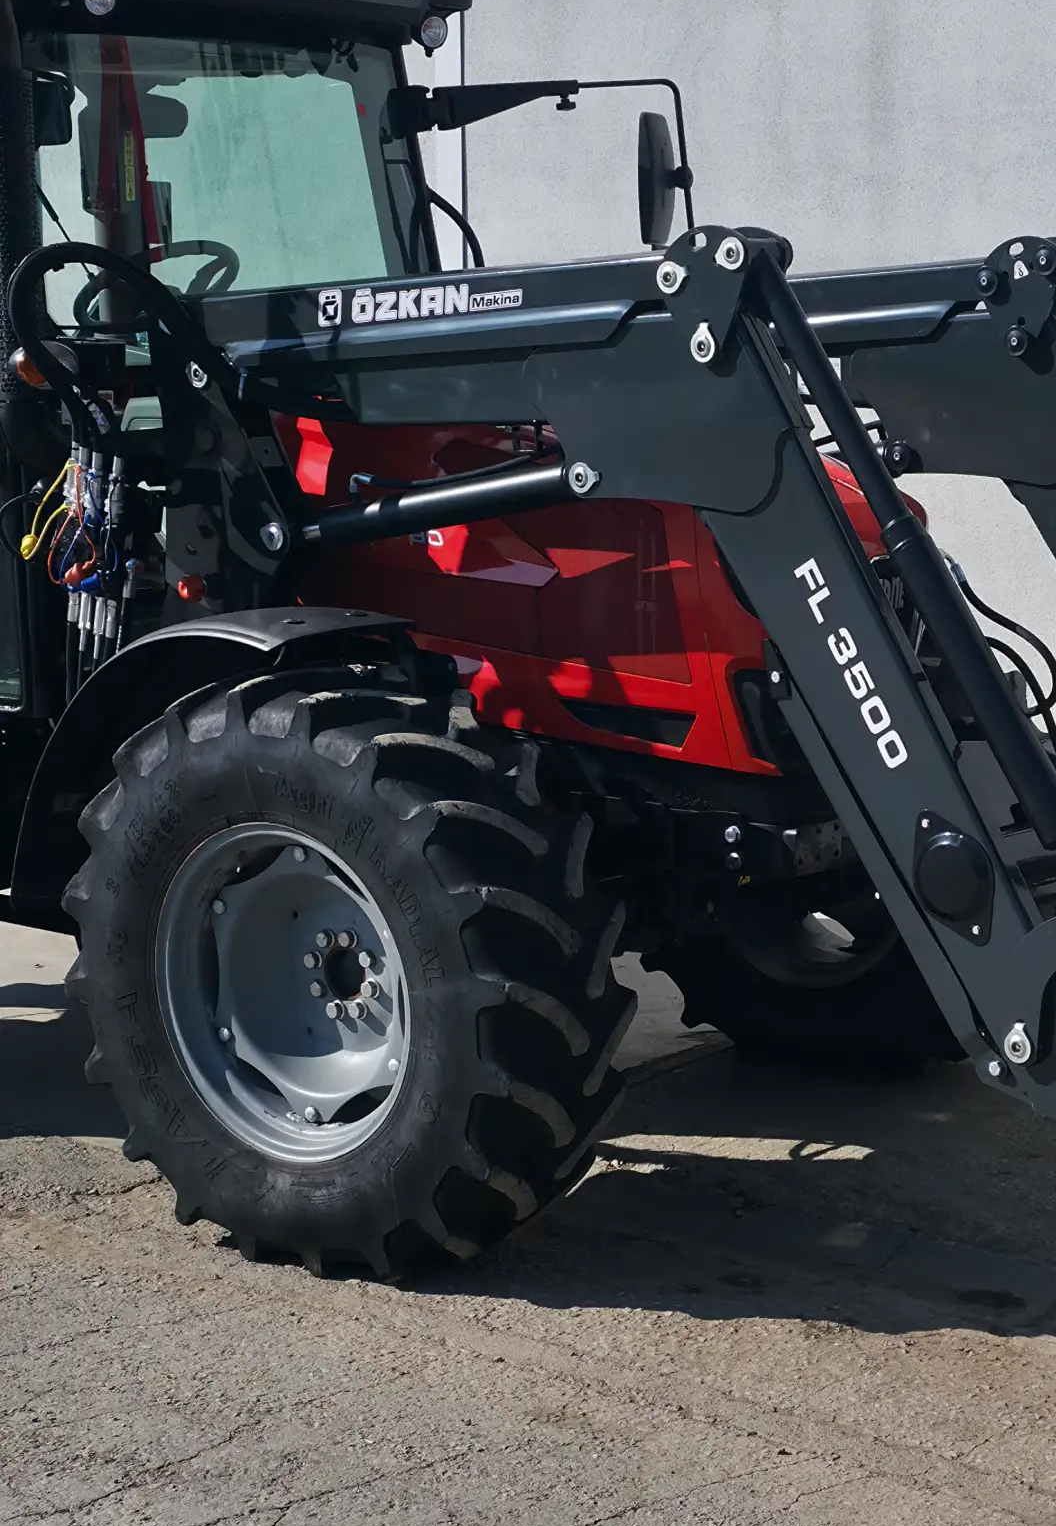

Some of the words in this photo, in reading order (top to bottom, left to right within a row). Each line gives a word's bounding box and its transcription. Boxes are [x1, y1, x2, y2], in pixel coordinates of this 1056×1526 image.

[352, 284, 469, 323] ÖZKAN
[471, 293, 521, 309] Makina
[793, 557, 831, 624] FL
[827, 627, 908, 769] 3500
